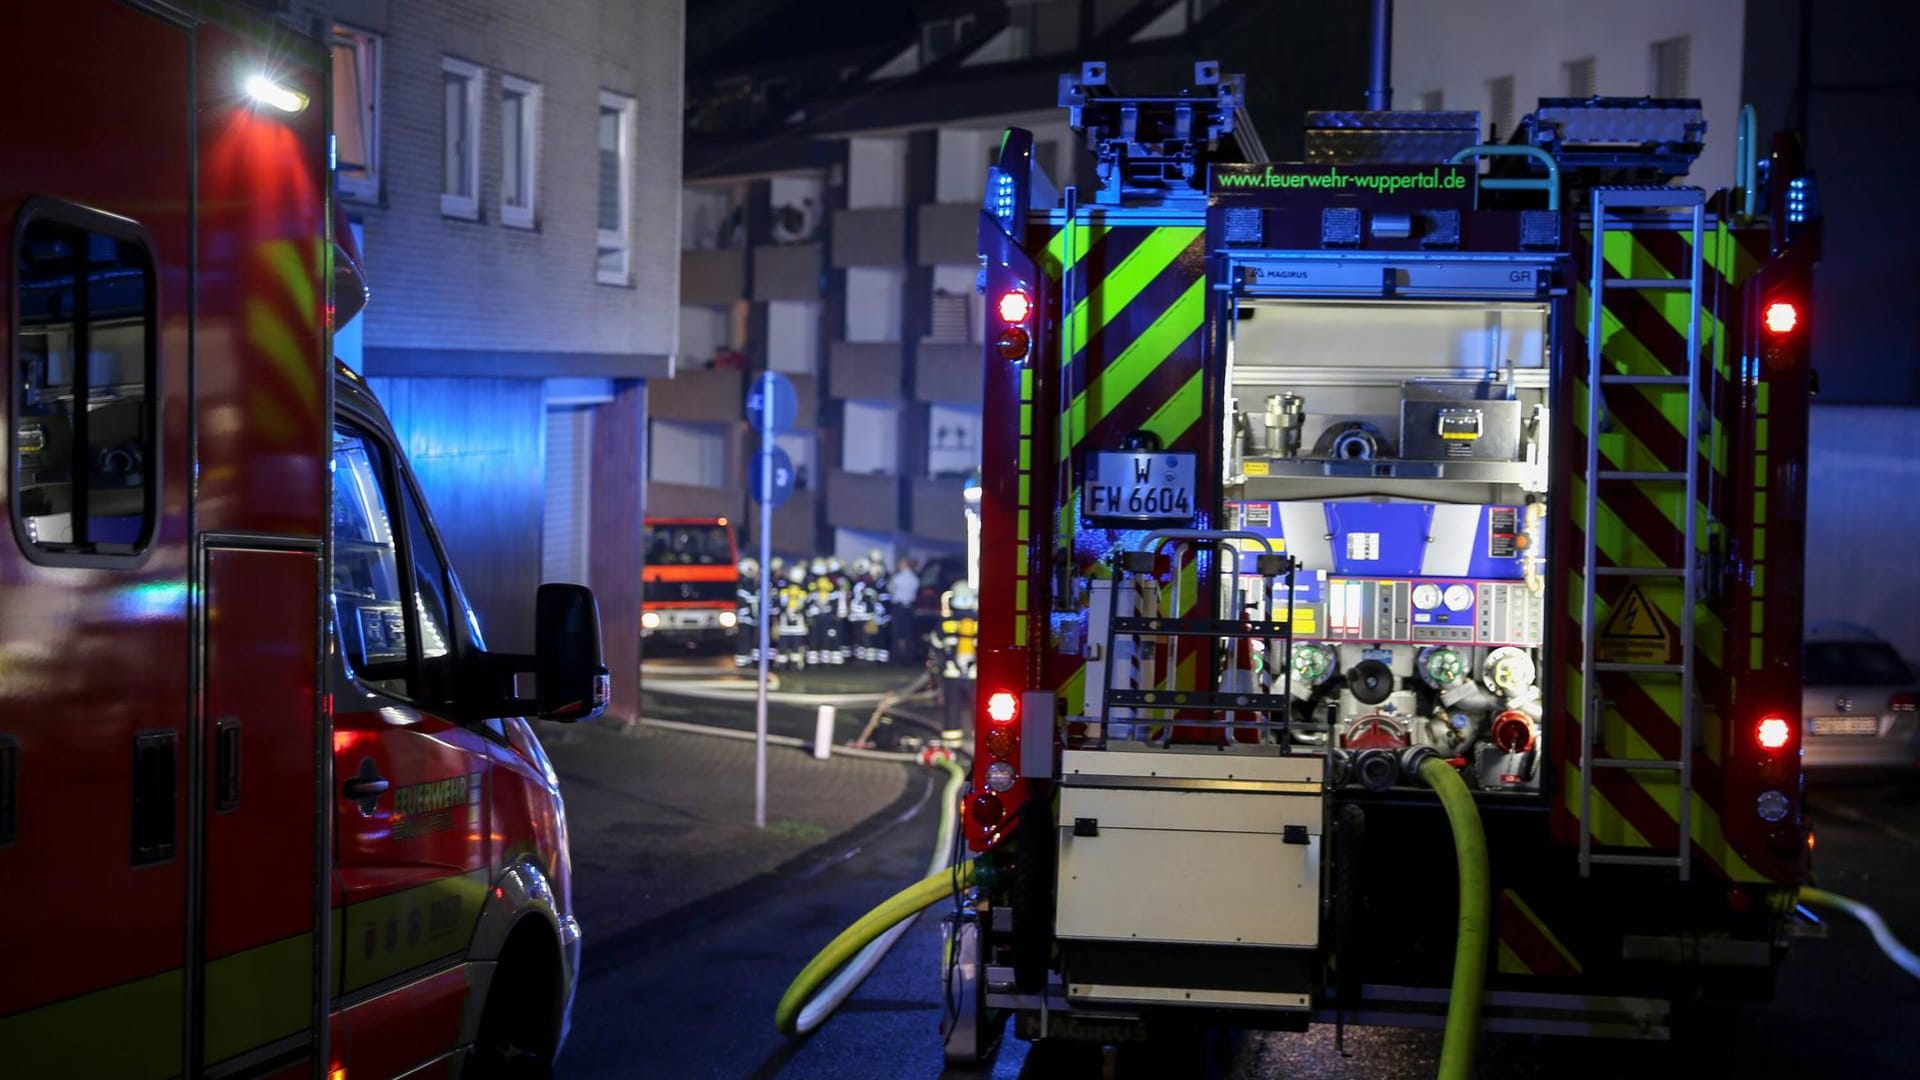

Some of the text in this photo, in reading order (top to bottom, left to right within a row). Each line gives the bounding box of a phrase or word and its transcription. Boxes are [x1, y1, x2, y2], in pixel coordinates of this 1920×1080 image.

[1218, 167, 1466, 194] www.feuerwehr-wuppertal.de
[1267, 271, 1309, 279] MAGIRUS
[1134, 458, 1152, 483] W
[1090, 486, 1188, 513] FW 6604
[394, 776, 467, 815] FEUERWEHR
